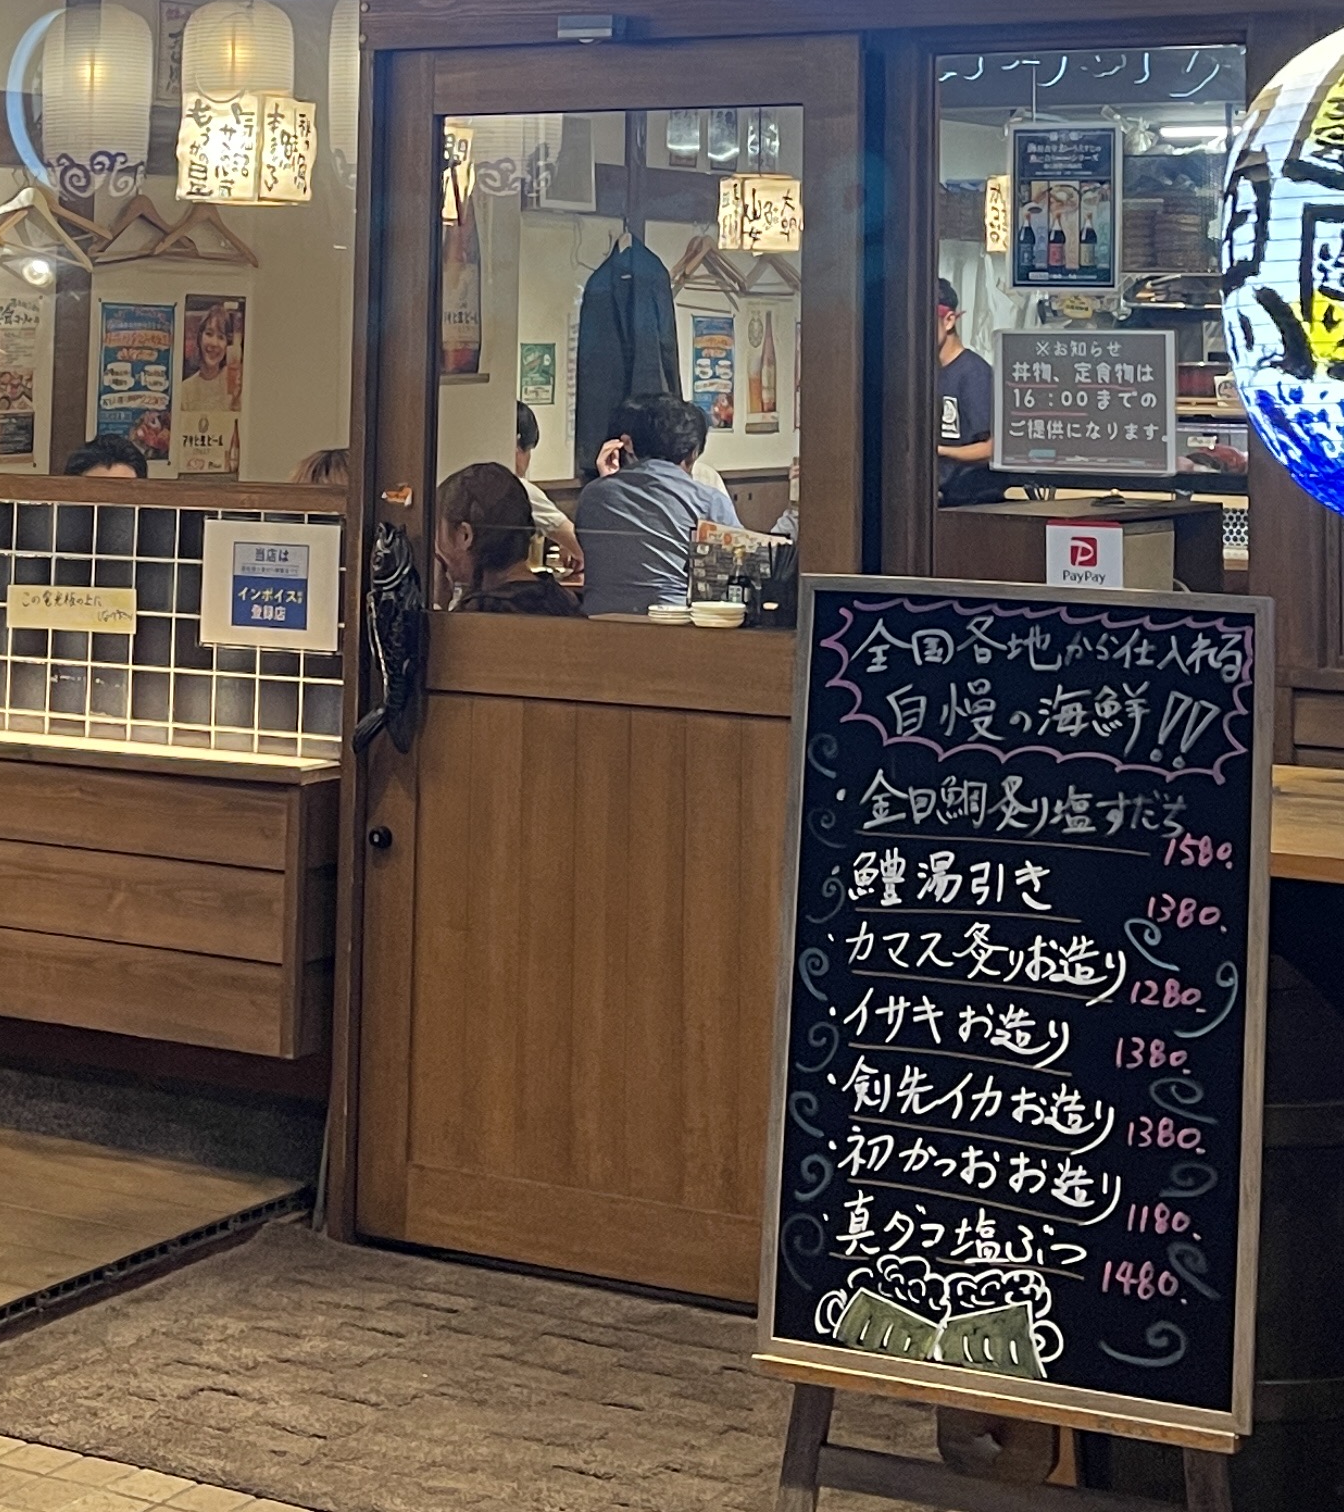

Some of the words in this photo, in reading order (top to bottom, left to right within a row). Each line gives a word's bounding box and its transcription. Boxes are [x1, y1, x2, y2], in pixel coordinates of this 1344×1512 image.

[1011, 360, 1155, 385] 丼物、定食物は
[1009, 417, 1169, 444] ご提供になります。
[255, 547, 290, 563] 当店は
[1062, 569, 1107, 586] PayPay
[851, 614, 1244, 683] 全国各地から仕入れる
[885, 677, 1220, 769] 自慢の海鮮!!
[848, 845, 1052, 911] 鱧湯引き
[844, 920, 1128, 1007] カマス炙りお造り
[842, 987, 1071, 1069] イサキお造り
[840, 1055, 1116, 1156] 剣先イカお造り
[836, 1125, 1122, 1227] 初かつおお造り
[835, 1189, 1088, 1266] 真ダコ塩ぶつ
